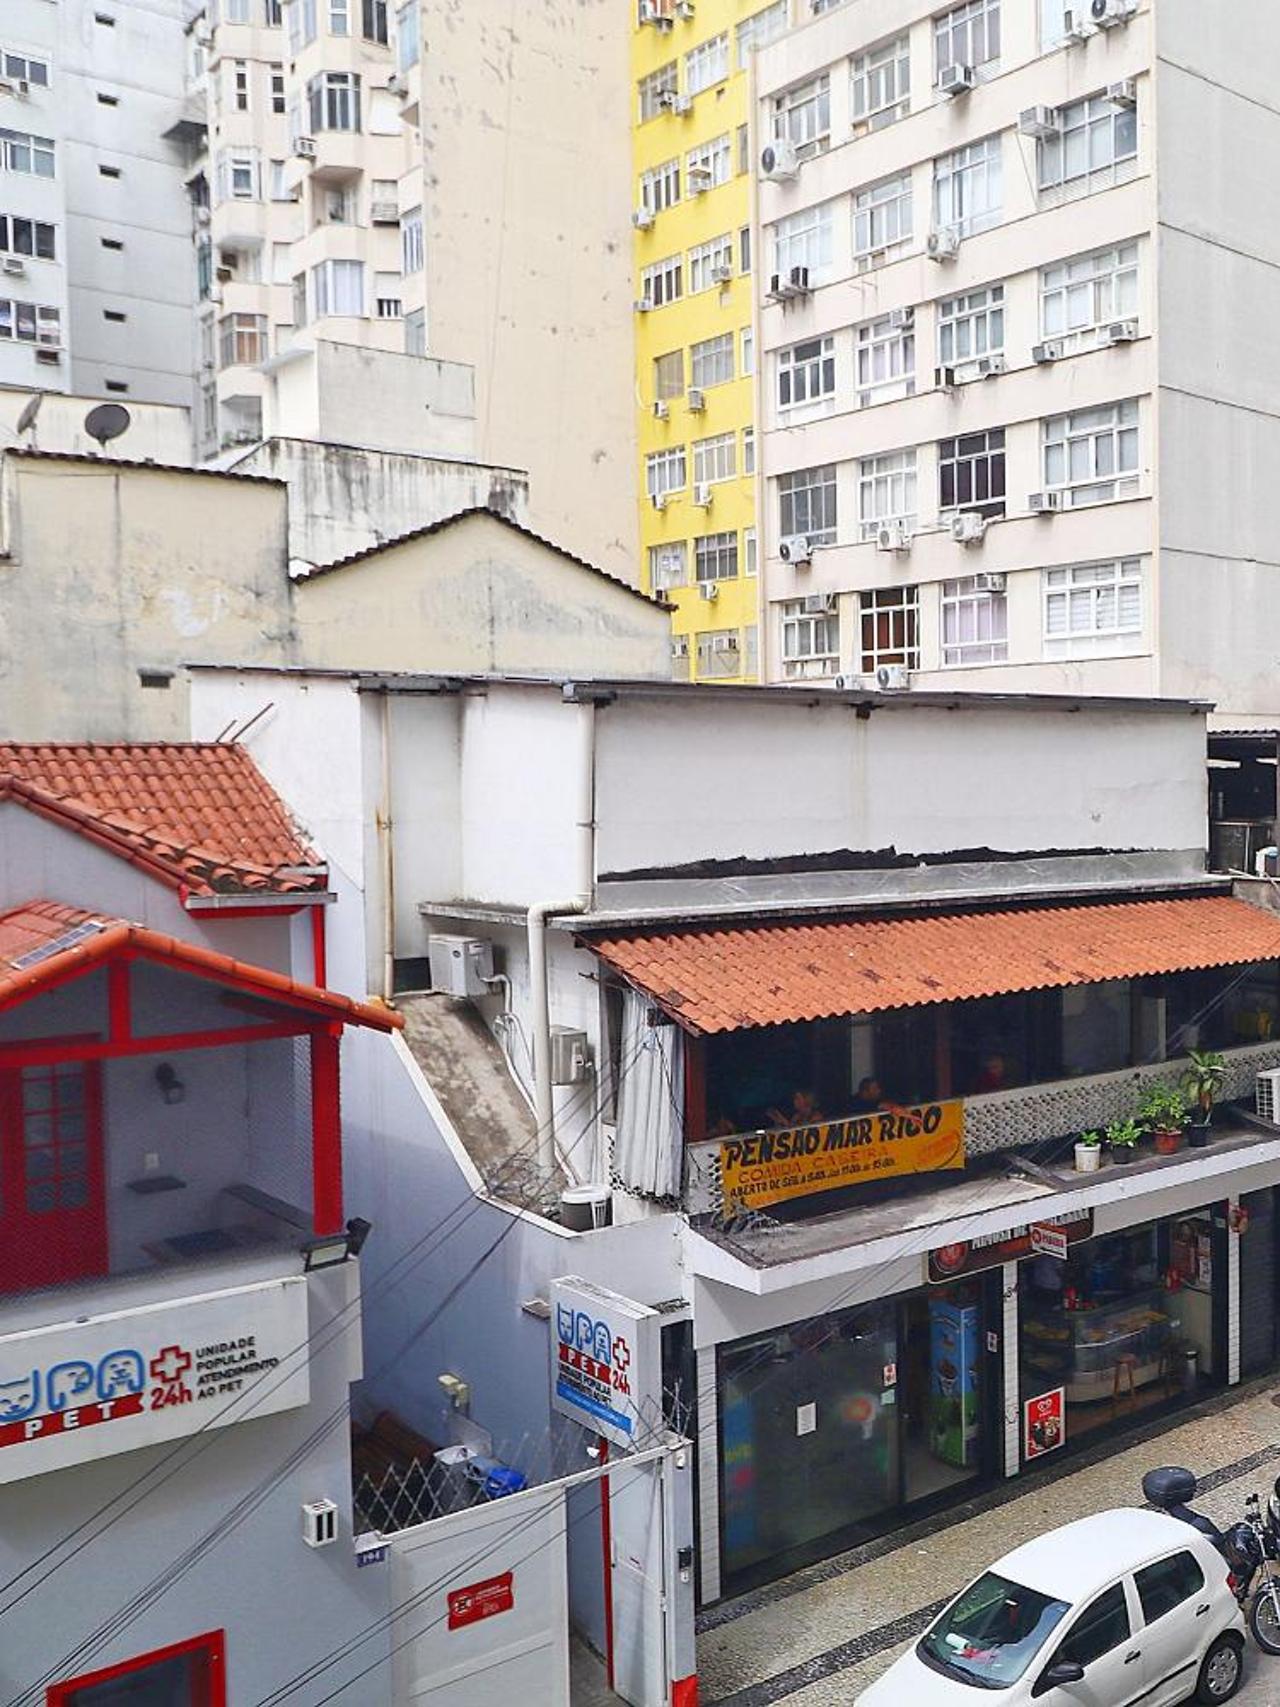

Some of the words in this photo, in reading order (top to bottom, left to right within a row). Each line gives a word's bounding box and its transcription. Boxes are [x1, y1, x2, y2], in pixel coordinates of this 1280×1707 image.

[824, 1117, 873, 1151] MAR
[738, 1161, 802, 1184] COMIDA
[730, 1182, 768, 1198] ABERTO
[195, 1336, 256, 1359] UNIDADE
[196, 1349, 257, 1373] POPULAR
[196, 1357, 280, 1387] ATENDIMENTO
[151, 1380, 193, 1412] 24h
[197, 1384, 217, 1401] AO
[218, 1378, 244, 1395] PET
[24, 1399, 118, 1439] PET
